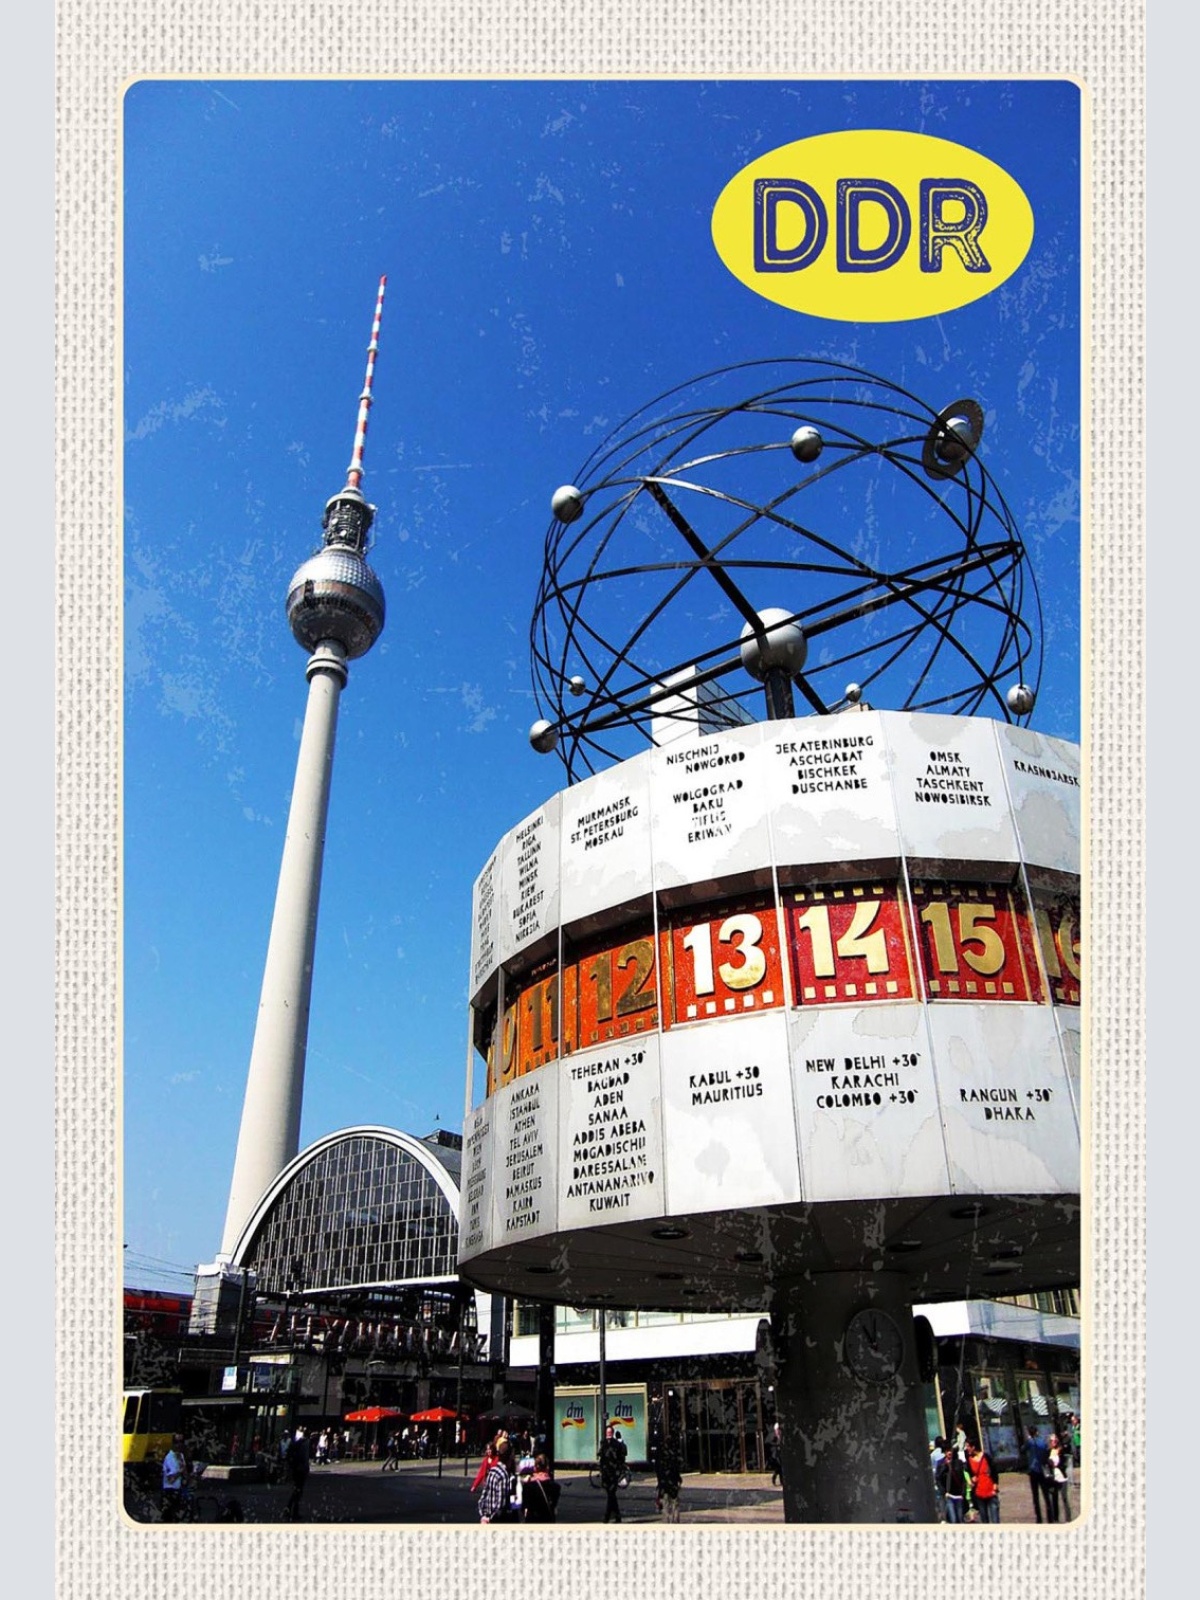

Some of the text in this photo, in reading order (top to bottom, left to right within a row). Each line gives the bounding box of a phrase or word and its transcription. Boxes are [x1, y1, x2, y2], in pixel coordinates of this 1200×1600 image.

[666, 744, 720, 765] NISCHNIJ
[776, 735, 874, 754] JEKATERINBURG
[686, 752, 745, 774] NOWGOROD
[789, 750, 863, 767] ASCHGABAT
[930, 751, 962, 763] OMSK
[797, 764, 858, 780] BISCHKEK
[926, 765, 970, 777] ALMATY
[1014, 760, 1080, 787] KRASNOJARSK
[673, 779, 743, 804] WOLGOGRAD
[791, 778, 868, 795] DUSCHANBE
[916, 777, 984, 792] TASCHKENT
[693, 797, 724, 813] BAKU
[915, 792, 991, 806] NOWOSIBIRSK
[577, 796, 631, 828] MURMANSK
[516, 815, 544, 843] HELSINKI
[571, 806, 639, 844] ST. PETERSBURG
[522, 834, 536, 850] RIGA
[585, 826, 624, 851] MOSKAU
[519, 857, 539, 876] WILNA
[519, 869, 538, 890] MINSK
[521, 883, 535, 901] KIEW
[513, 890, 545, 920] BUKAREST
[519, 909, 537, 929] SOFIA
[799, 900, 890, 978] 14
[921, 902, 1006, 975] 15
[683, 913, 767, 997] 13
[589, 939, 657, 1022] 12
[528, 973, 559, 1051] 11
[571, 1058, 620, 1080] TEHERAN
[806, 1058, 835, 1073] NEW
[844, 1055, 886, 1070] DELHI
[587, 1072, 630, 1093] BAGDAD
[690, 1066, 760, 1088] KABUL +30
[831, 1073, 899, 1090] KARACHI
[510, 1083, 540, 1105] ANKARA
[594, 1090, 624, 1108] ADEN
[692, 1082, 763, 1106] MAURITIUS
[816, 1092, 882, 1109] COLOMBO
[960, 1088, 1018, 1102] RANGUN
[588, 1106, 628, 1125] SANAA
[984, 1107, 1036, 1120] DHAKA
[513, 1114, 535, 1134] ATHEN
[573, 1120, 646, 1145] ADDIS ABEBA
[510, 1129, 539, 1151] TEL AVIV
[506, 1143, 543, 1168] JERUSALEM
[512, 1162, 535, 1181] BEIRUT
[506, 1176, 542, 1199] DAMASKUS
[567, 1171, 655, 1198] ANTANANARIVO
[512, 1196, 533, 1214] KAIRO
[589, 1193, 631, 1212] KUWAIT
[506, 1210, 540, 1232] KAPSTADT
[566, 1402, 583, 1418] dm
[615, 1400, 633, 1417] dm
